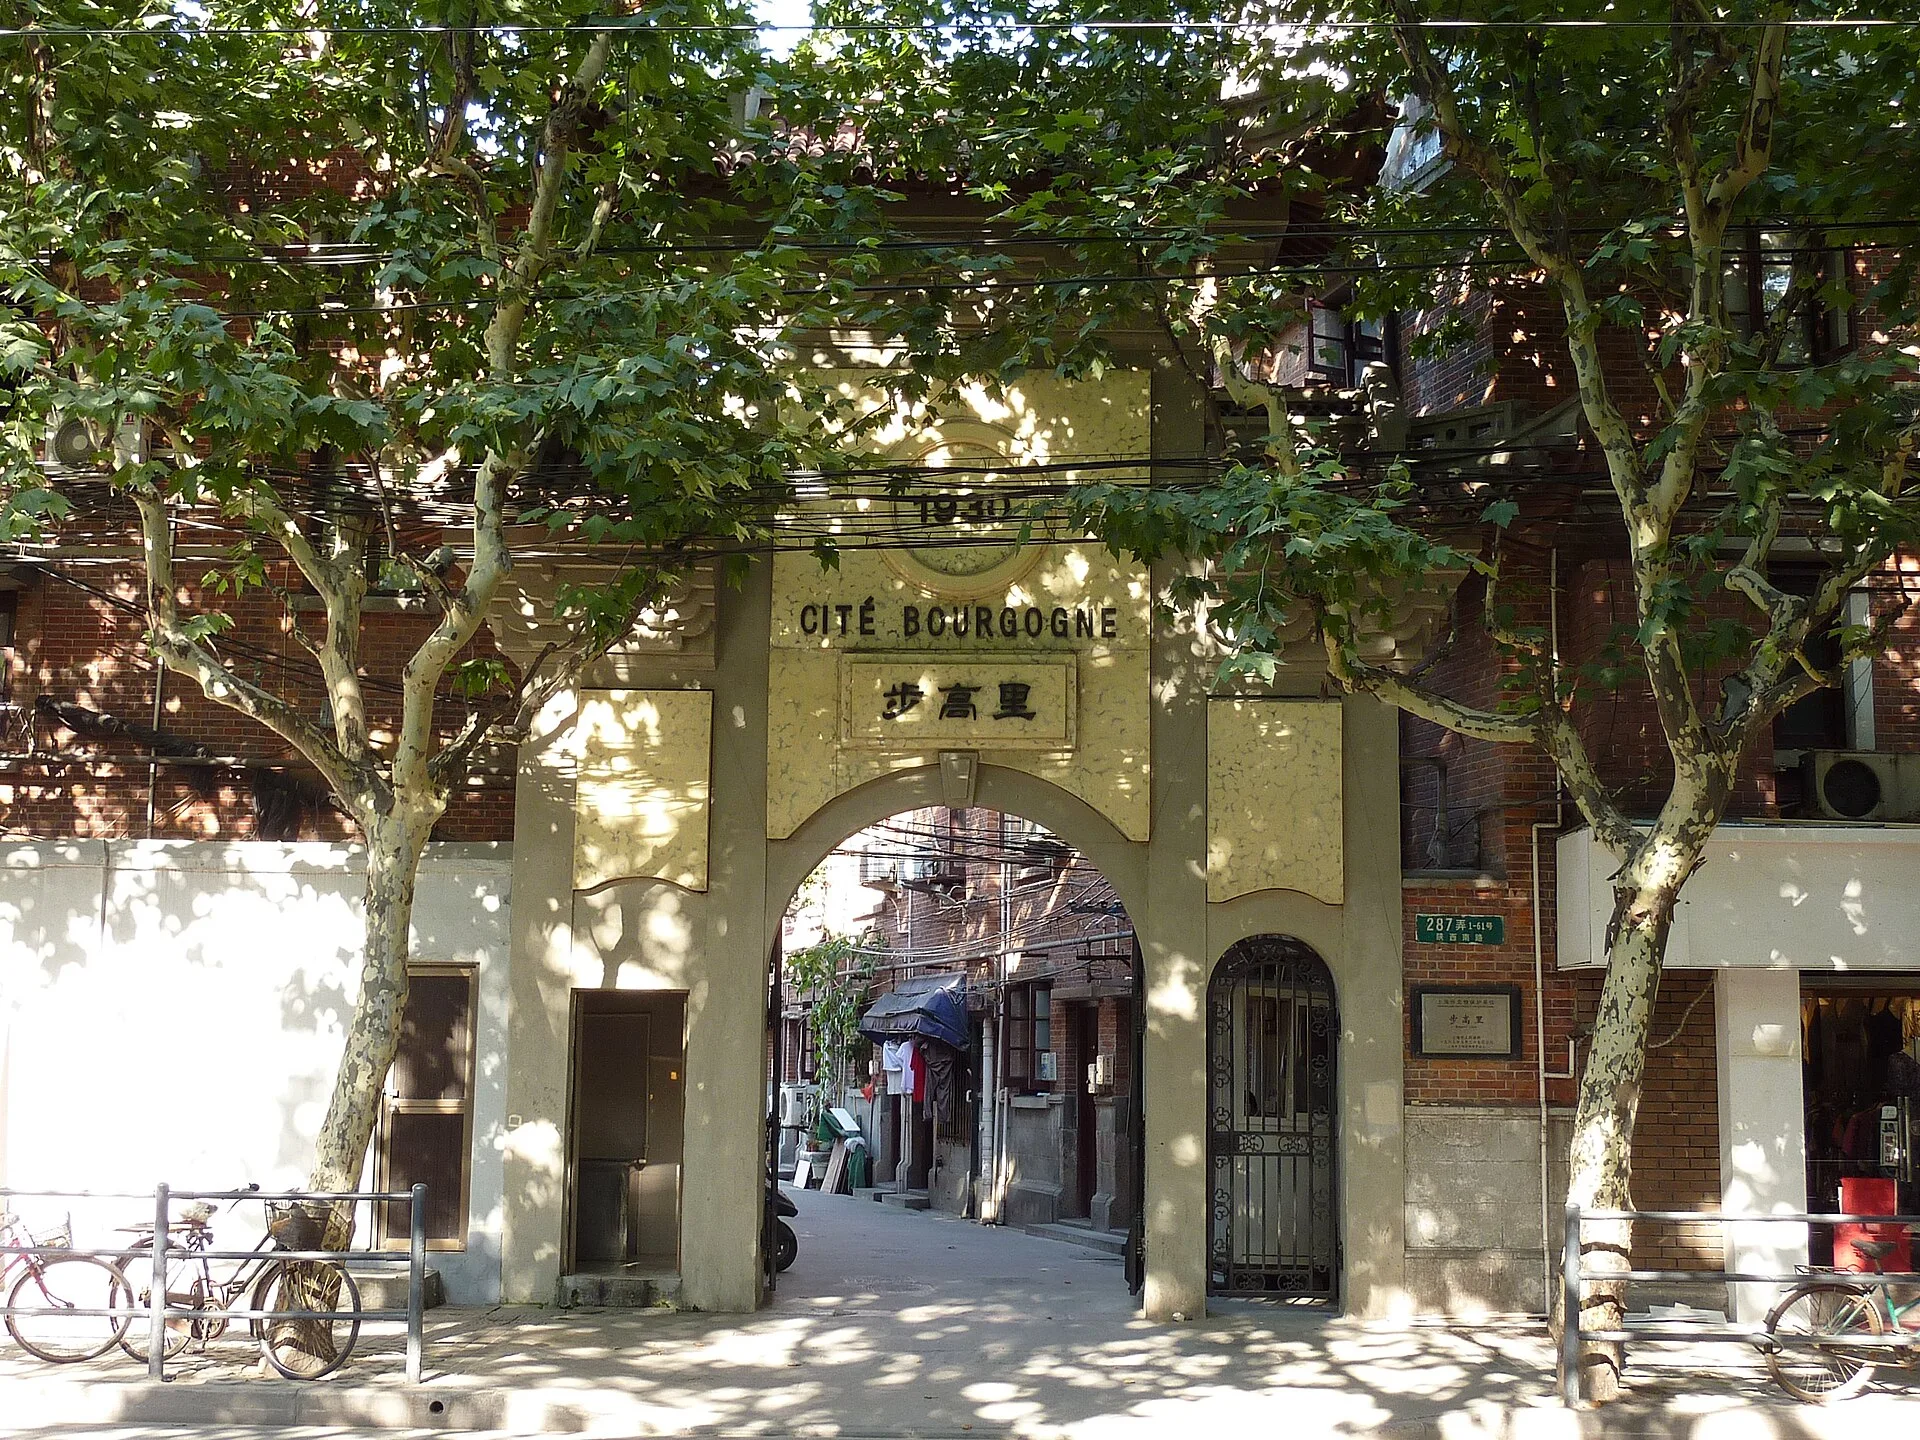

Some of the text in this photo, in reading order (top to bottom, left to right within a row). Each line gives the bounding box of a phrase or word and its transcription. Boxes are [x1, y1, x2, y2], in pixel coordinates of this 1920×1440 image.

[800, 596, 1117, 638] CITÉ BOURGOGNE
[882, 681, 1036, 721] 步高里
[1436, 933, 1483, 942] 陕西南路
[1449, 1014, 1484, 1025] 步高里
